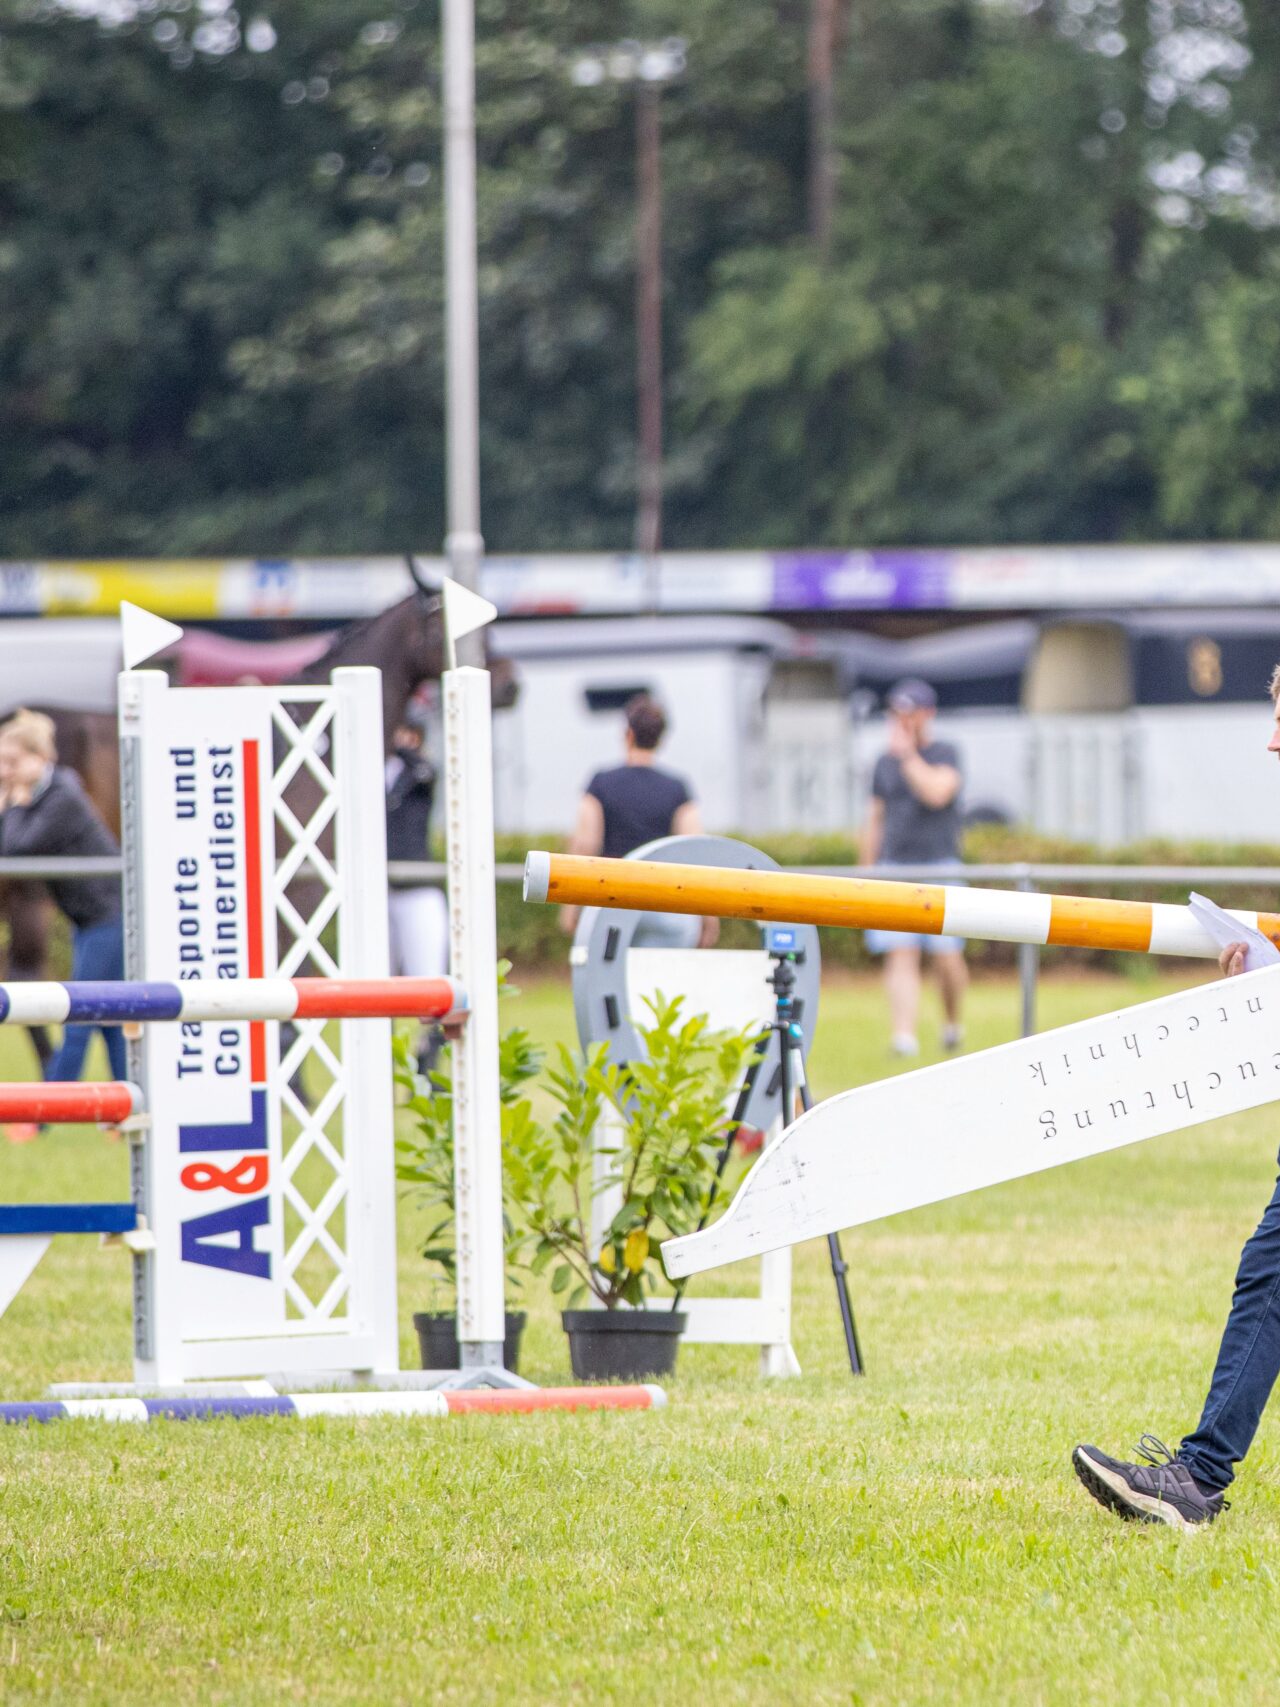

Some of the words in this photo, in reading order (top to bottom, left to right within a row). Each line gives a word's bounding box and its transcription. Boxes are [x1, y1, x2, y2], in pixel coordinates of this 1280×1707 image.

[170, 747, 197, 820] und
[174, 857, 204, 1079] Trasporte
[208, 745, 240, 1076] Coainerdienst
[178, 1088, 272, 1281] A&L
